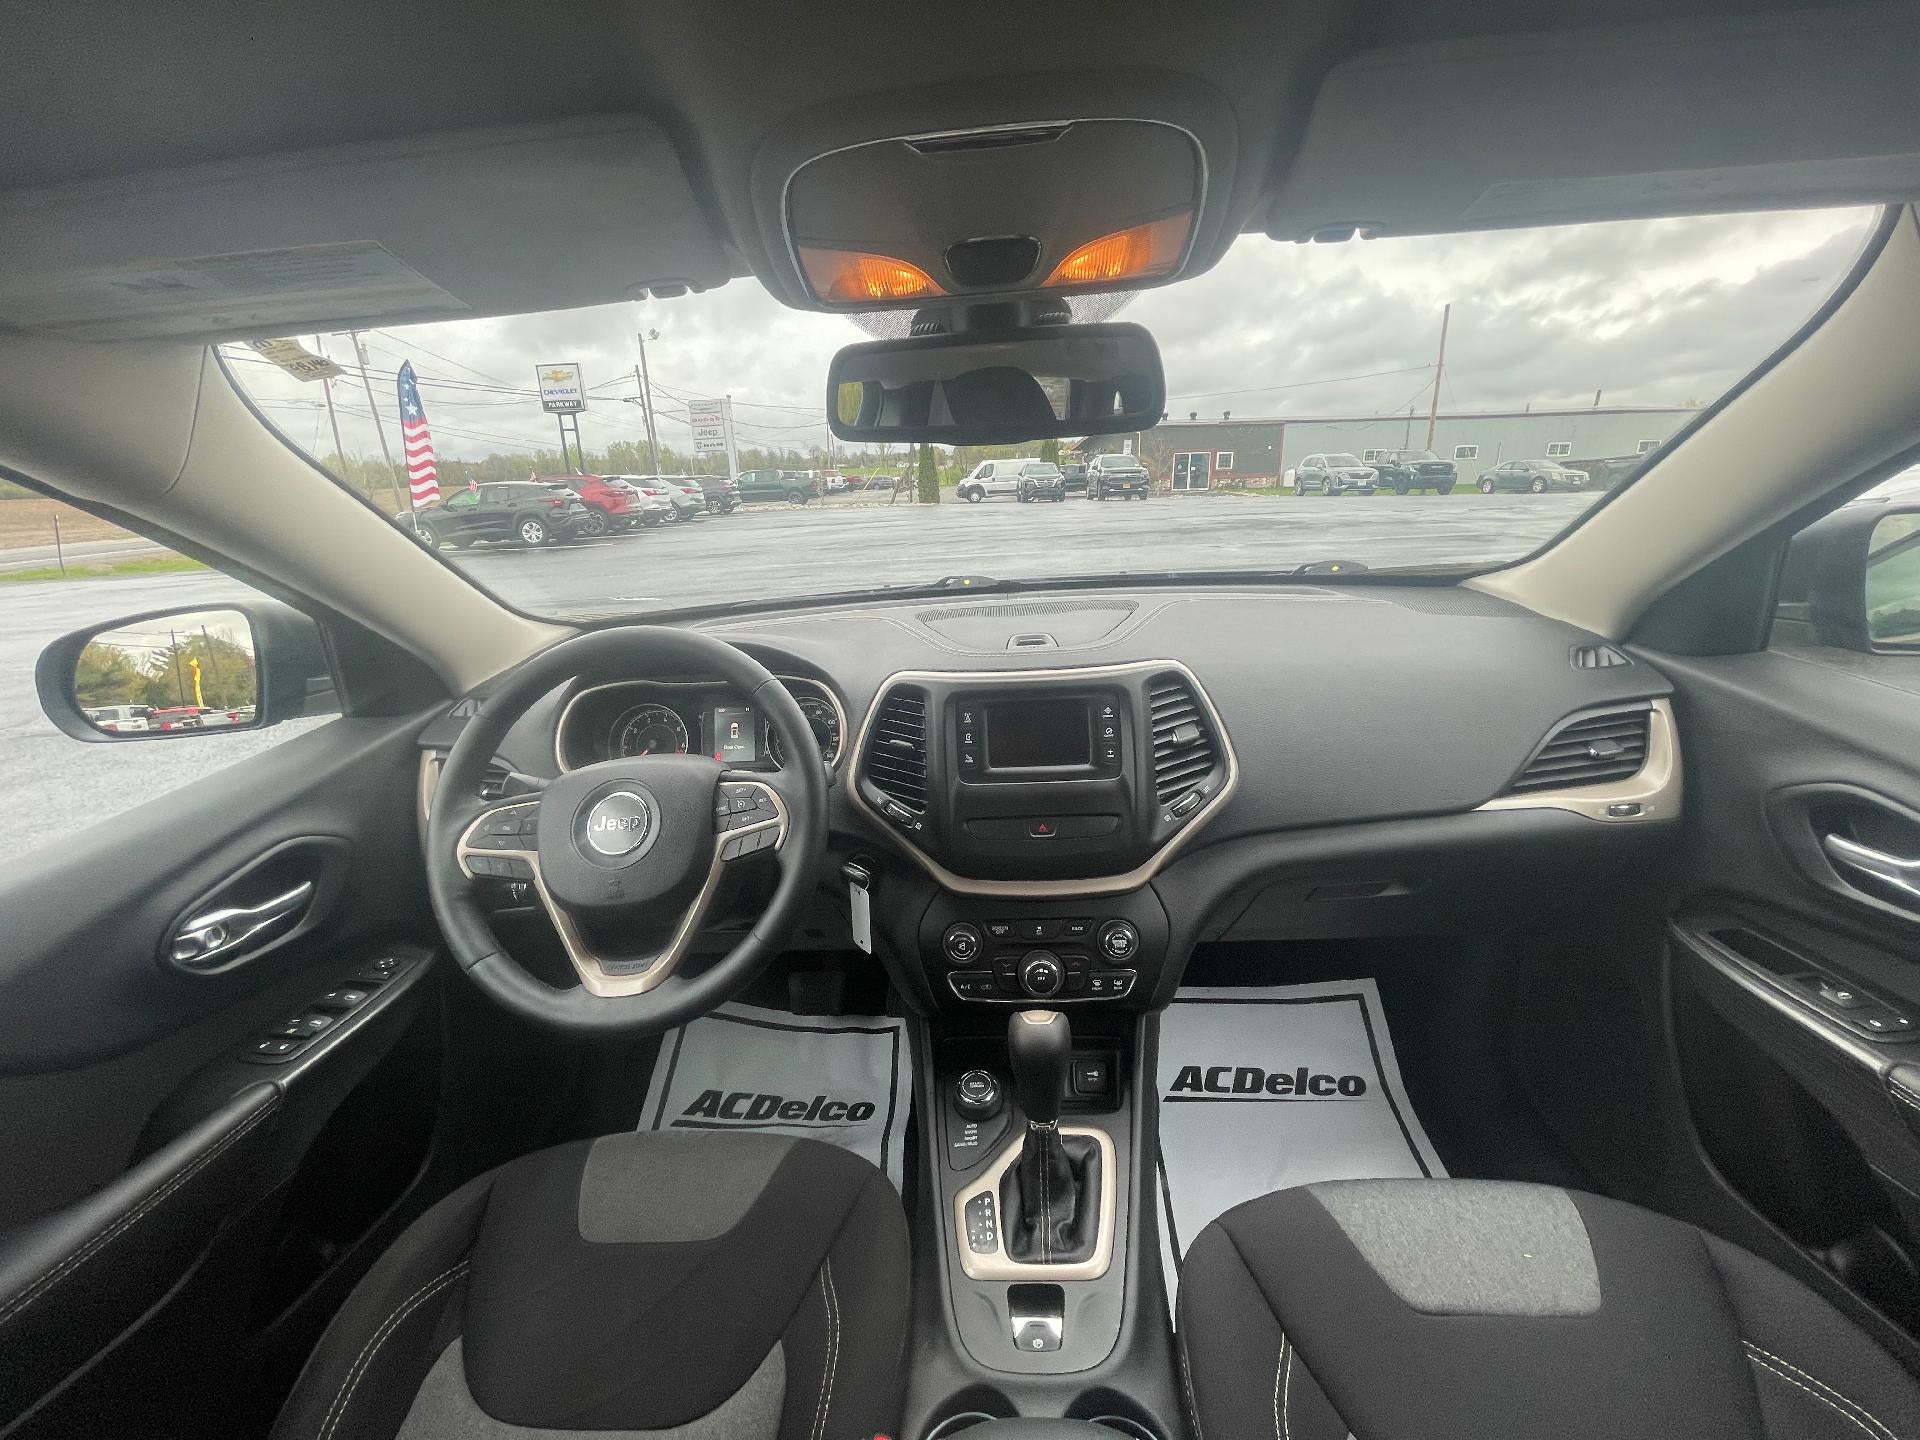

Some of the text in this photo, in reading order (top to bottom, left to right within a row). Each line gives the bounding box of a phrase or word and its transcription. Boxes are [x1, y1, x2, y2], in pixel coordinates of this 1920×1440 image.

[548, 400, 577, 408] PARKWAY
[698, 428, 718, 437] Jeep
[593, 815, 641, 832] Jeep
[1169, 1065, 1367, 1097] ACDelco
[681, 1089, 876, 1122] ACDelco
[984, 1197, 991, 1206] P
[985, 1209, 992, 1217] R
[985, 1219, 993, 1229] N
[986, 1231, 994, 1241] D
